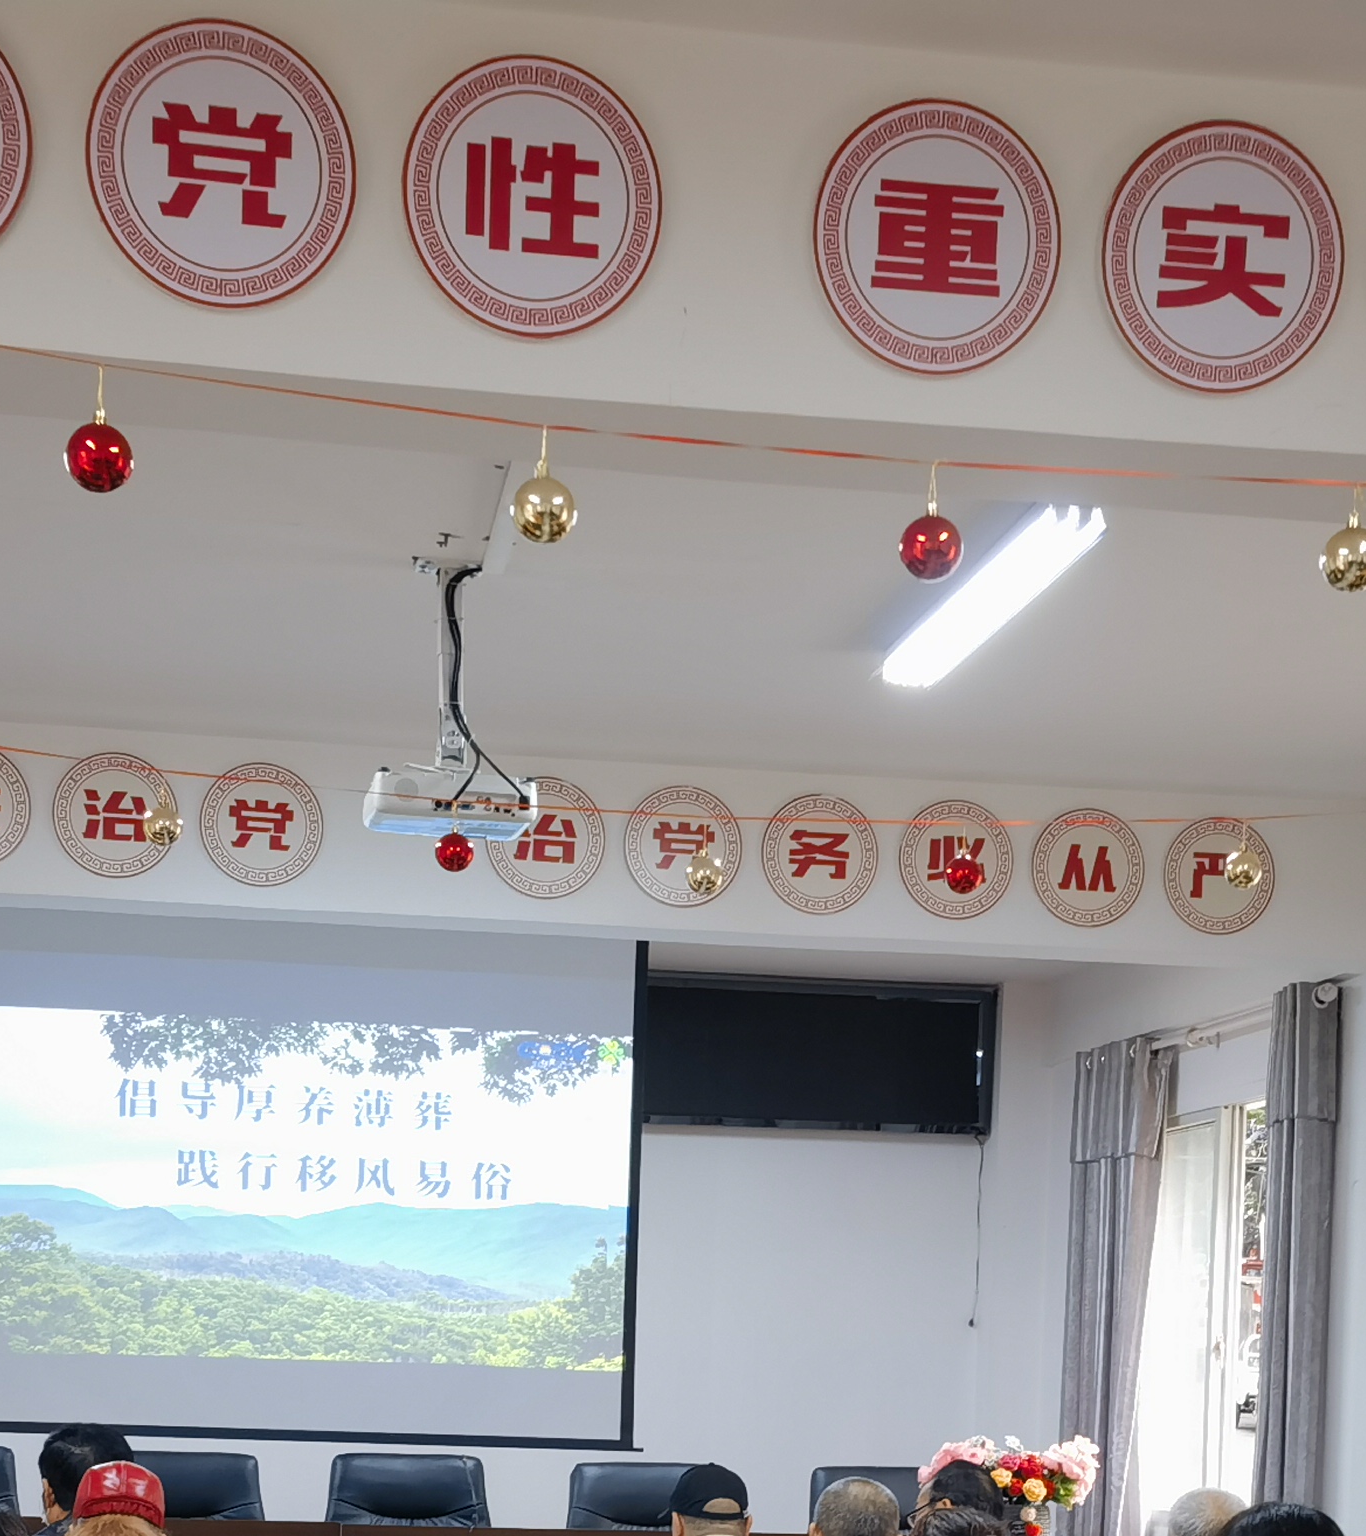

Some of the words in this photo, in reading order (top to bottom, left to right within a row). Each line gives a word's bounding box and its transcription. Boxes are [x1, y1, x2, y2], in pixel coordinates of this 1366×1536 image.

[114, 1076, 453, 1132] 倡导厚养薄葬
[175, 1148, 513, 1201] 践行移风易俗
